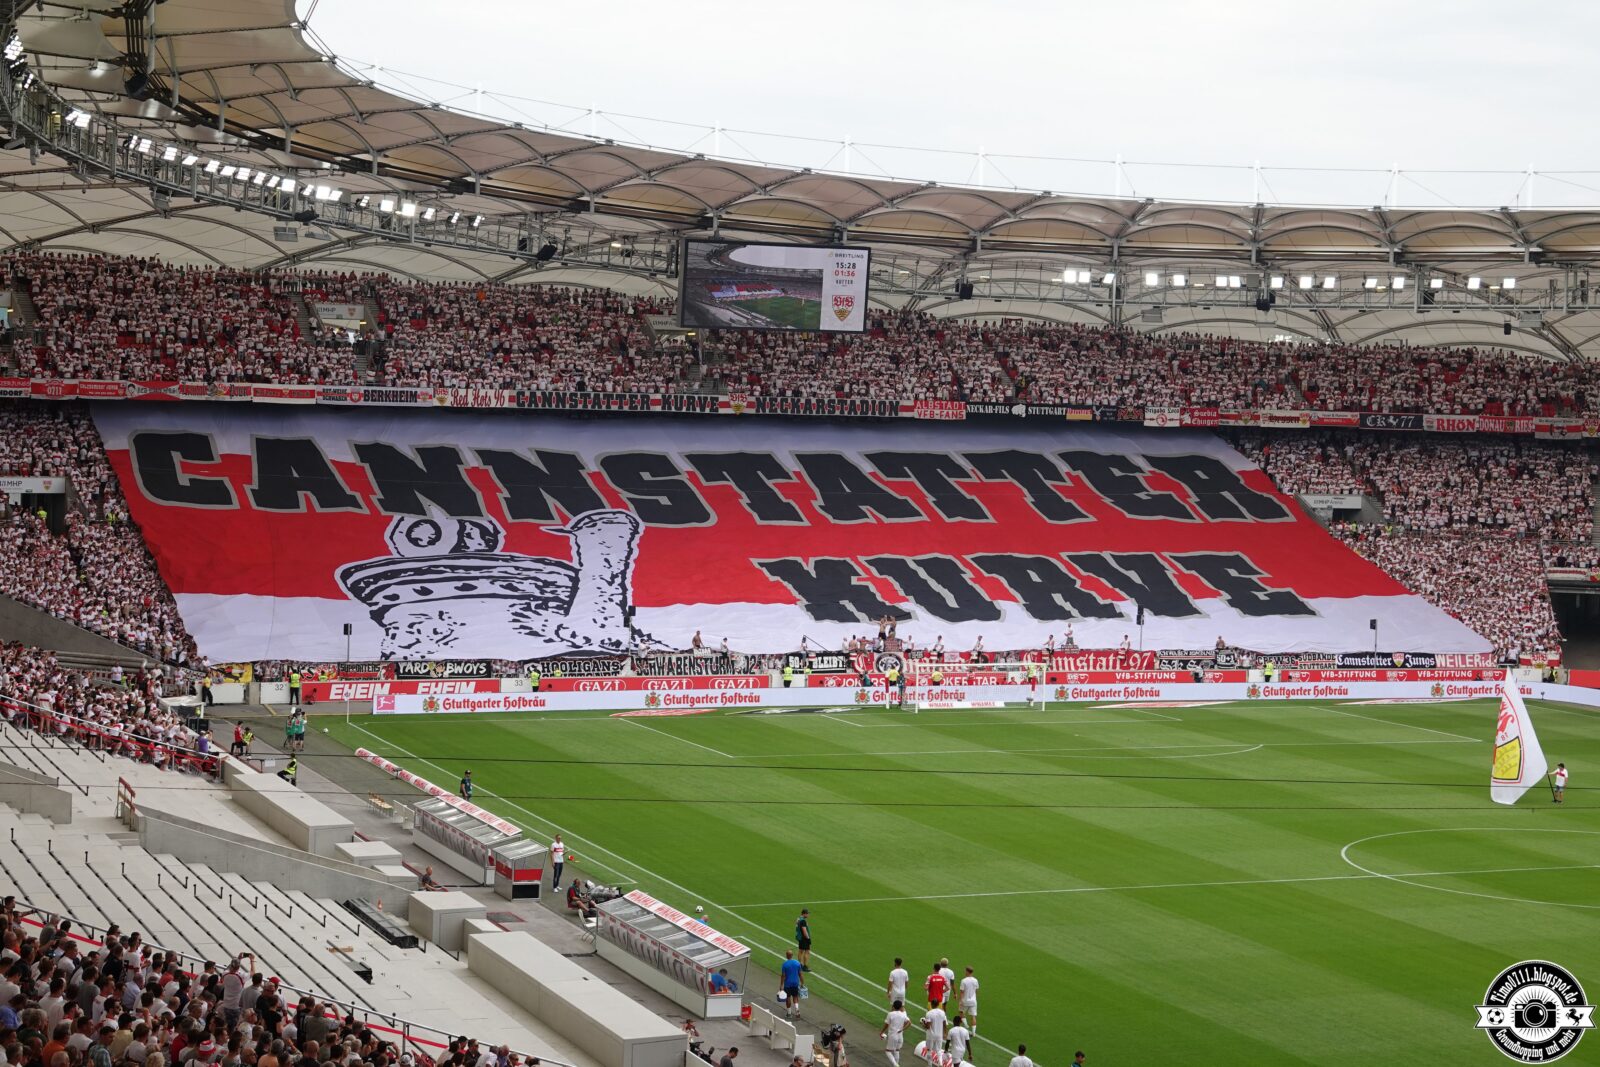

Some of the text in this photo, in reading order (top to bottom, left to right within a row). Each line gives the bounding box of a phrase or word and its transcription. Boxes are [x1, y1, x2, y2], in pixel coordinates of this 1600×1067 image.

[836, 262, 856, 271] 15:28
[363, 390, 417, 403] BERKHEIM
[450, 387, 505, 407] Red Hots 96
[515, 391, 719, 412] CANNSTATTER KURVE
[755, 397, 899, 417] NECKARSTADION
[916, 401, 965, 410] ALBSTADT
[967, 405, 1010, 416] NECKAR-FILS
[1028, 407, 1067, 417] STUTTGART
[918, 411, 964, 420] VFB-FANS
[1401, 416, 1415, 428] 77
[1437, 417, 1476, 432] RHÖN
[1480, 419, 1533, 432] DONAU RIES
[127, 428, 1302, 529] CANNSTATTER
[750, 551, 1325, 623] KURVE
[398, 661, 486, 675] YARD BWOYS
[541, 661, 620, 674] HOOLIGANS
[1298, 663, 1336, 671] STUTTGART
[1337, 654, 1435, 670] Cannstatter Jungs
[1115, 672, 1176, 680] VfB-STIFTUNG
[1321, 670, 1376, 679] VfB-STIFTUNG
[1417, 670, 1472, 678] VfB-STIFTUNG
[330, 683, 390, 702] EHEIM
[417, 682, 475, 694] EHEIM
[1071, 687, 1160, 700] Stuttgarter Hofbräu
[1263, 685, 1348, 698] Stuttgarter Hofbräu
[1446, 684, 1493, 697] Stuttgarter
[663, 692, 760, 707] Stuttgarter Hofbräu
[927, 690, 965, 701] Hofbräu
[443, 696, 545, 711] Stuttgarter Hofbräu
